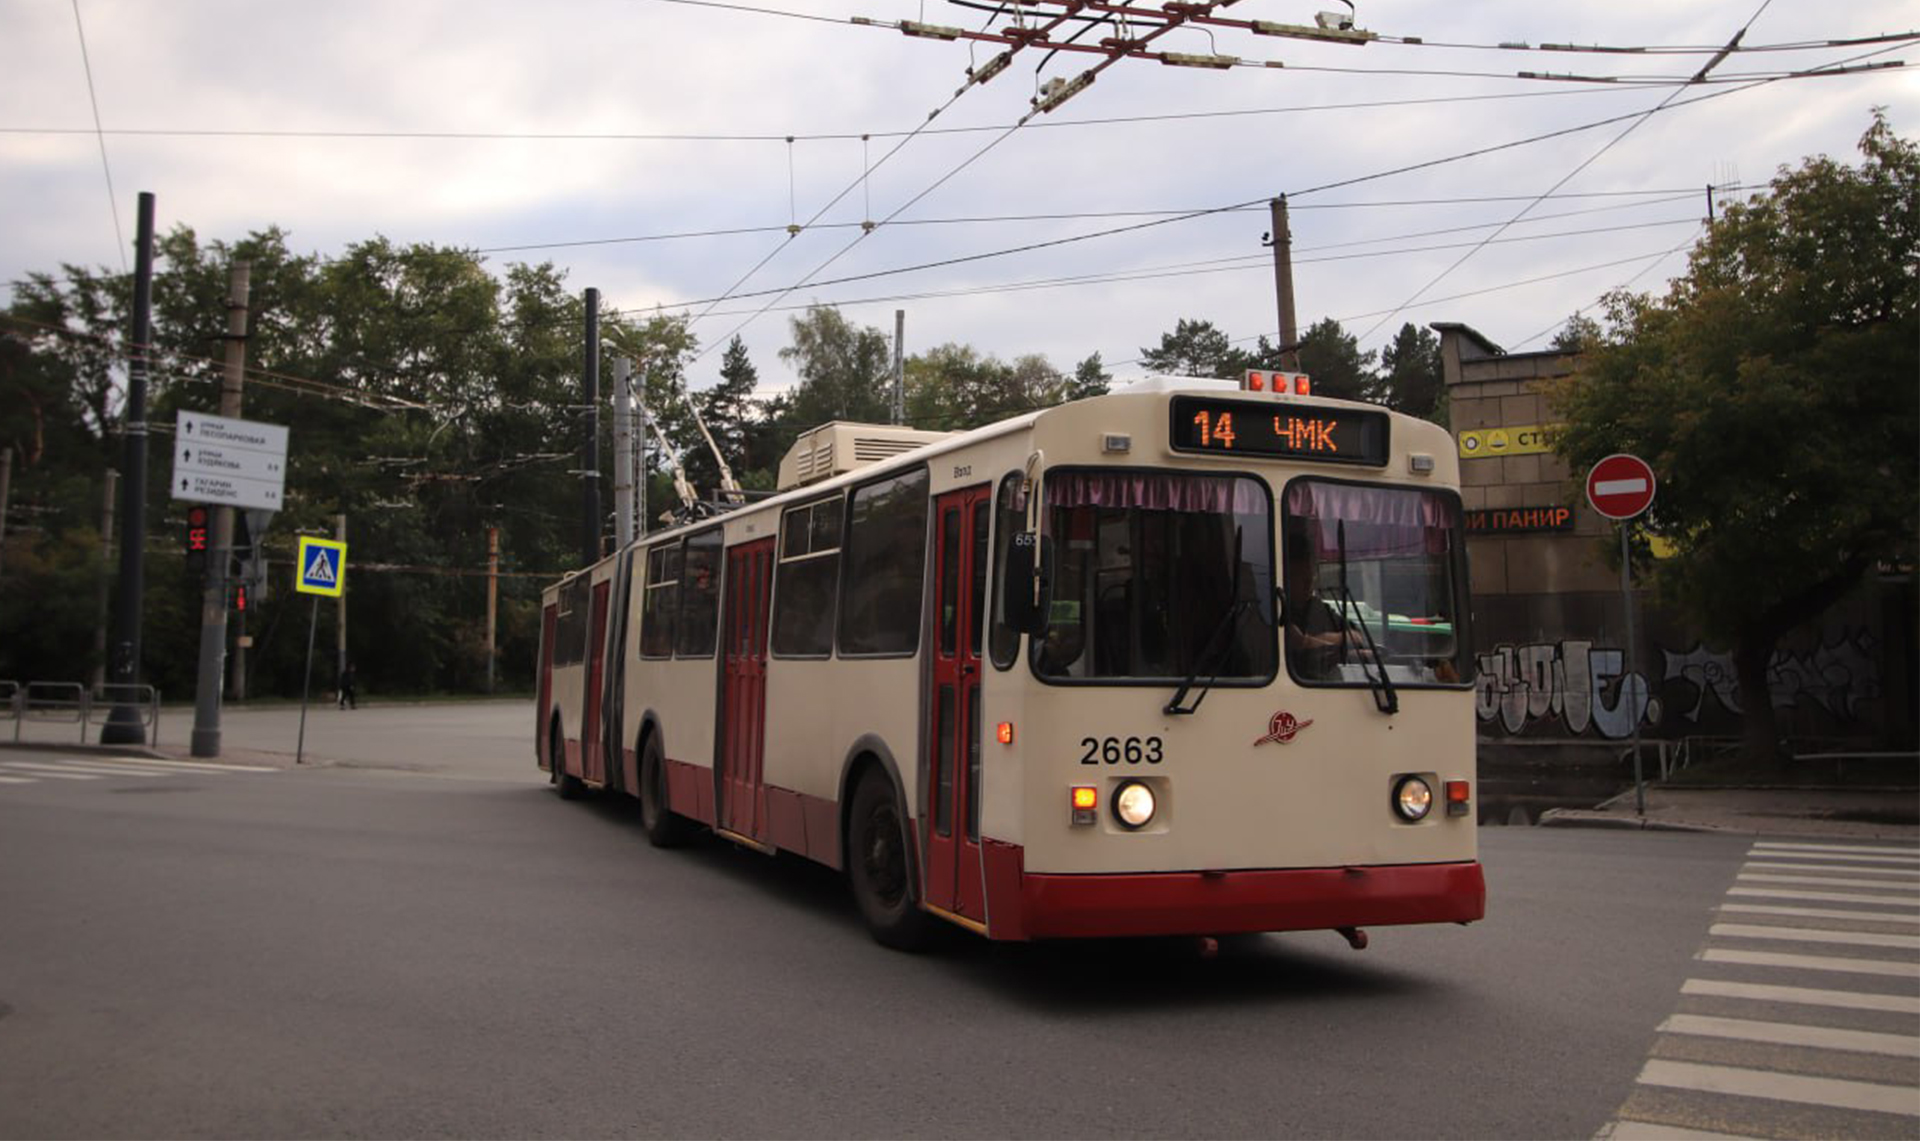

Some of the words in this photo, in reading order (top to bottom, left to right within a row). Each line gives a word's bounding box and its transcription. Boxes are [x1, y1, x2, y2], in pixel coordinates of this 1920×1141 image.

[1194, 410, 1236, 448] 14
[1273, 416, 1338, 452] ЧМК
[1493, 508, 1570, 529] ПАНИР
[1080, 736, 1164, 765] 2663
